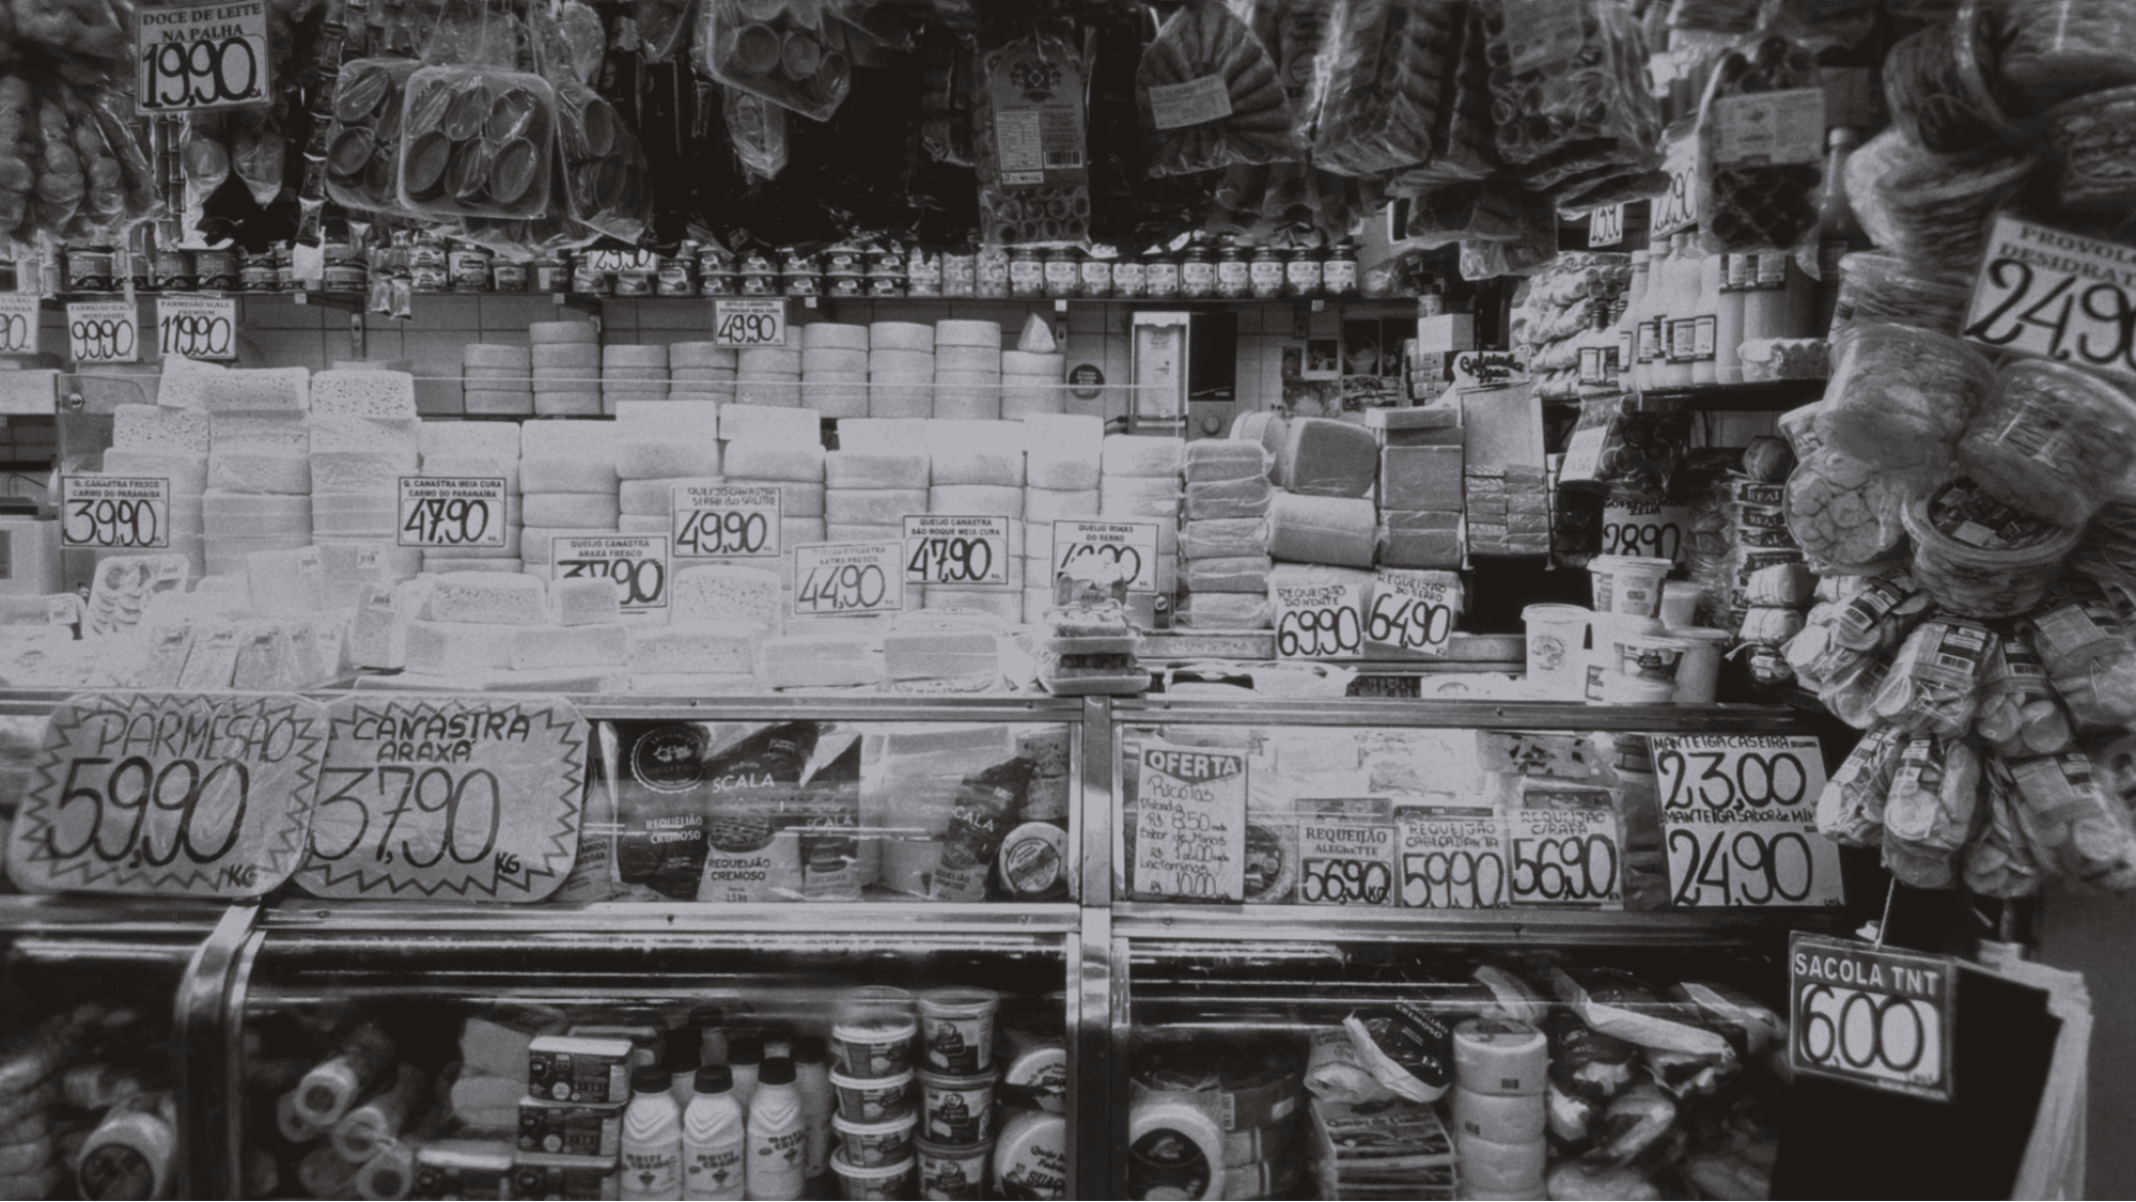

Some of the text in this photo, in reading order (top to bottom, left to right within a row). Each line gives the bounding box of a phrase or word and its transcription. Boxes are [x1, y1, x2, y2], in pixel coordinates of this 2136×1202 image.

[143, 2, 261, 26] DOCE DE LEITE
[162, 23, 243, 42] NA PALHA
[142, 37, 257, 108] 19,90
[2020, 226, 2136, 265] PROVOL
[85, 480, 127, 488] CANASTRA
[129, 480, 160, 488] FRESCO
[414, 480, 456, 488] CANASTRA
[480, 480, 502, 488] CURA
[404, 498, 489, 544] 47,90
[676, 509, 767, 554] 49,90
[919, 518, 992, 526] QUEIJO CANASTRA
[929, 528, 956, 536] ROQUE
[1078, 524, 1134, 533] QUEIJO MINAS
[570, 540, 603, 548] QUEIJO
[1099, 534, 1125, 542] SERRO
[907, 537, 992, 583] 47,90
[798, 564, 886, 611] 44,90
[1278, 605, 1361, 657] 69,90
[1368, 593, 1451, 648] 64,90
[353, 712, 530, 742] CANASTRA
[1654, 735, 1790, 750] MANTEIGA CASEIRA
[1149, 751, 1239, 779] OFERTA
[712, 772, 775, 794] SCALA
[1657, 750, 1807, 811] 23,00
[46, 756, 249, 868] 59,90
[310, 766, 521, 874] 37,90 KG
[645, 813, 703, 830] REQUEIJÃO
[806, 814, 855, 830] SCALA
[1665, 808, 1735, 824] MANTEIGA
[650, 830, 701, 844] CREMOSO
[1306, 826, 1387, 845] REQUEIJÃO
[1314, 844, 1378, 856] ALEGRETTE
[708, 857, 771, 868] REQUEIJÃO
[1513, 833, 1617, 900] 56,90
[1669, 828, 1813, 906] 24,90
[229, 864, 257, 887] KG
[710, 871, 766, 881] CREMOSO
[1302, 859, 1391, 905] 56,90
[1795, 953, 1939, 995] SACOLA TNT
[1800, 984, 1926, 1073] 6,00
